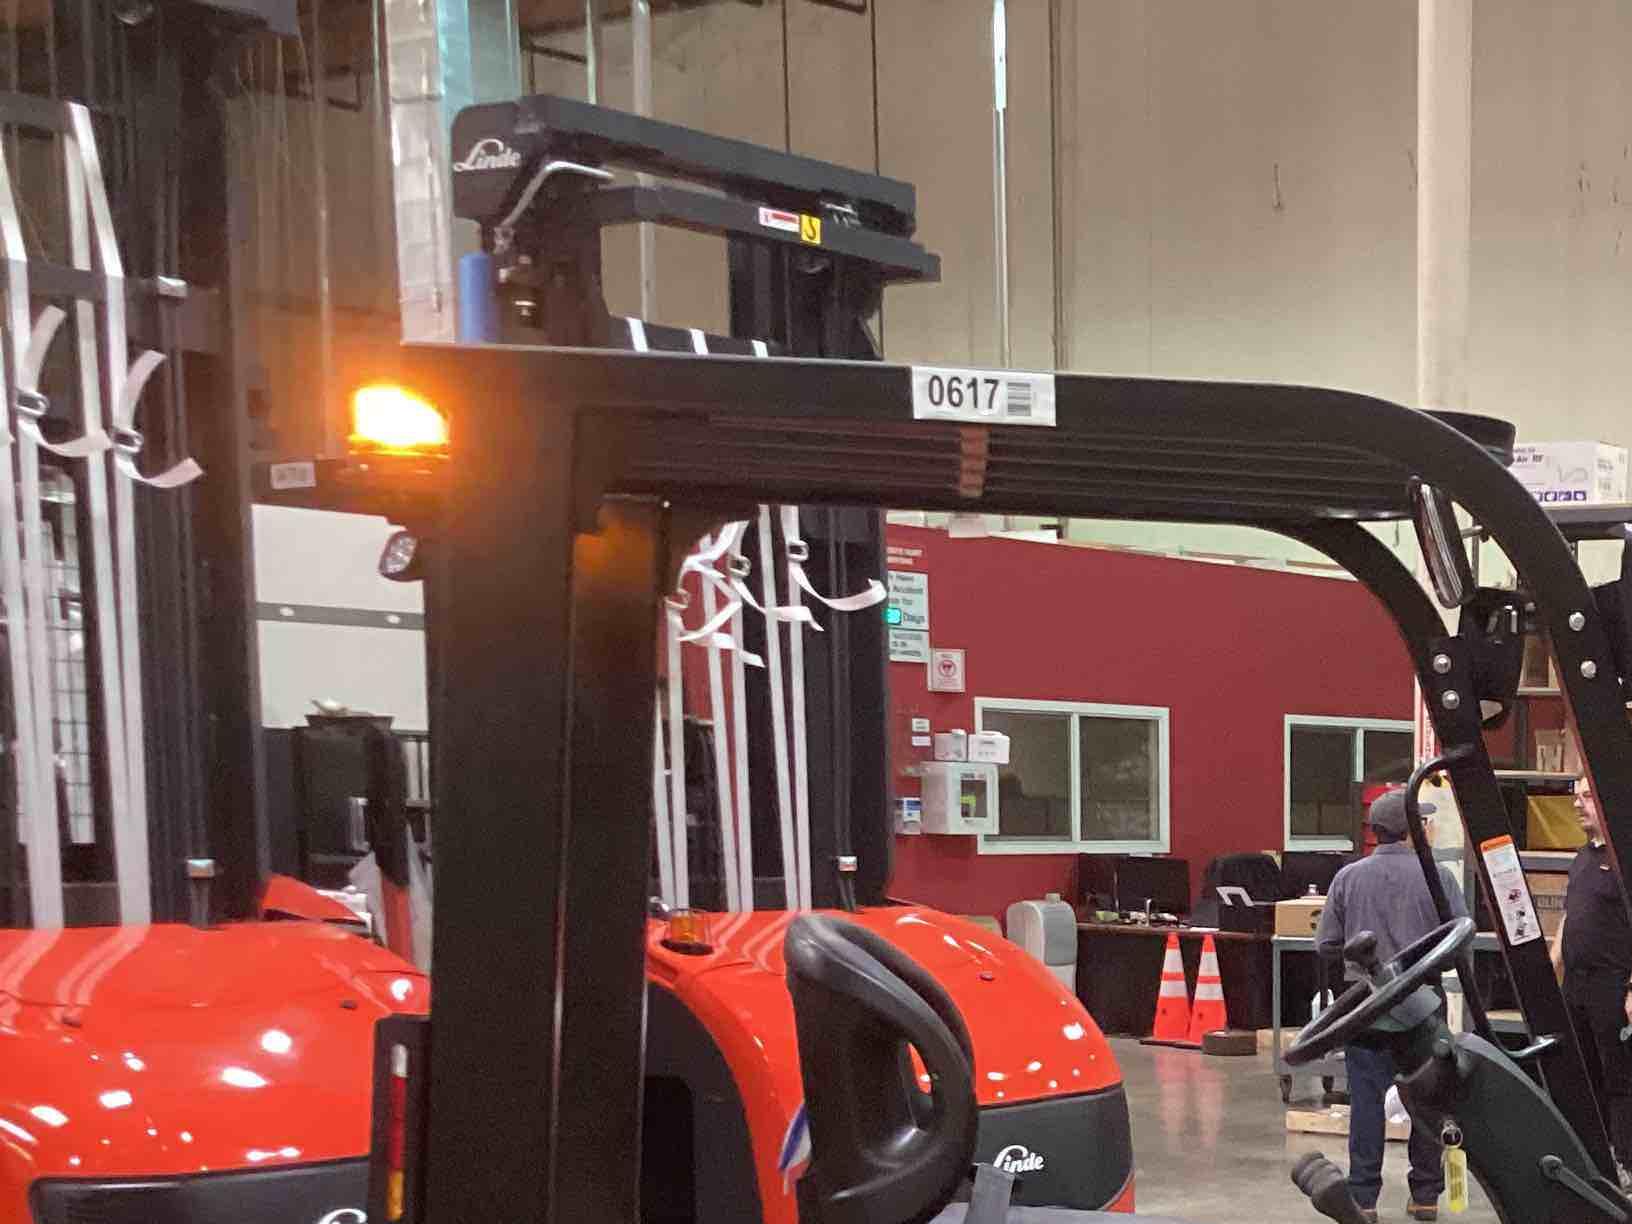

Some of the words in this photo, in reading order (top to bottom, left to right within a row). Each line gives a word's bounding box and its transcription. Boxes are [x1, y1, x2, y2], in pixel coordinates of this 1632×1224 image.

[453, 138, 521, 173] Linde
[928, 375, 1000, 409] 0617
[903, 612, 925, 625] Days
[993, 1145, 1044, 1173] Linde
